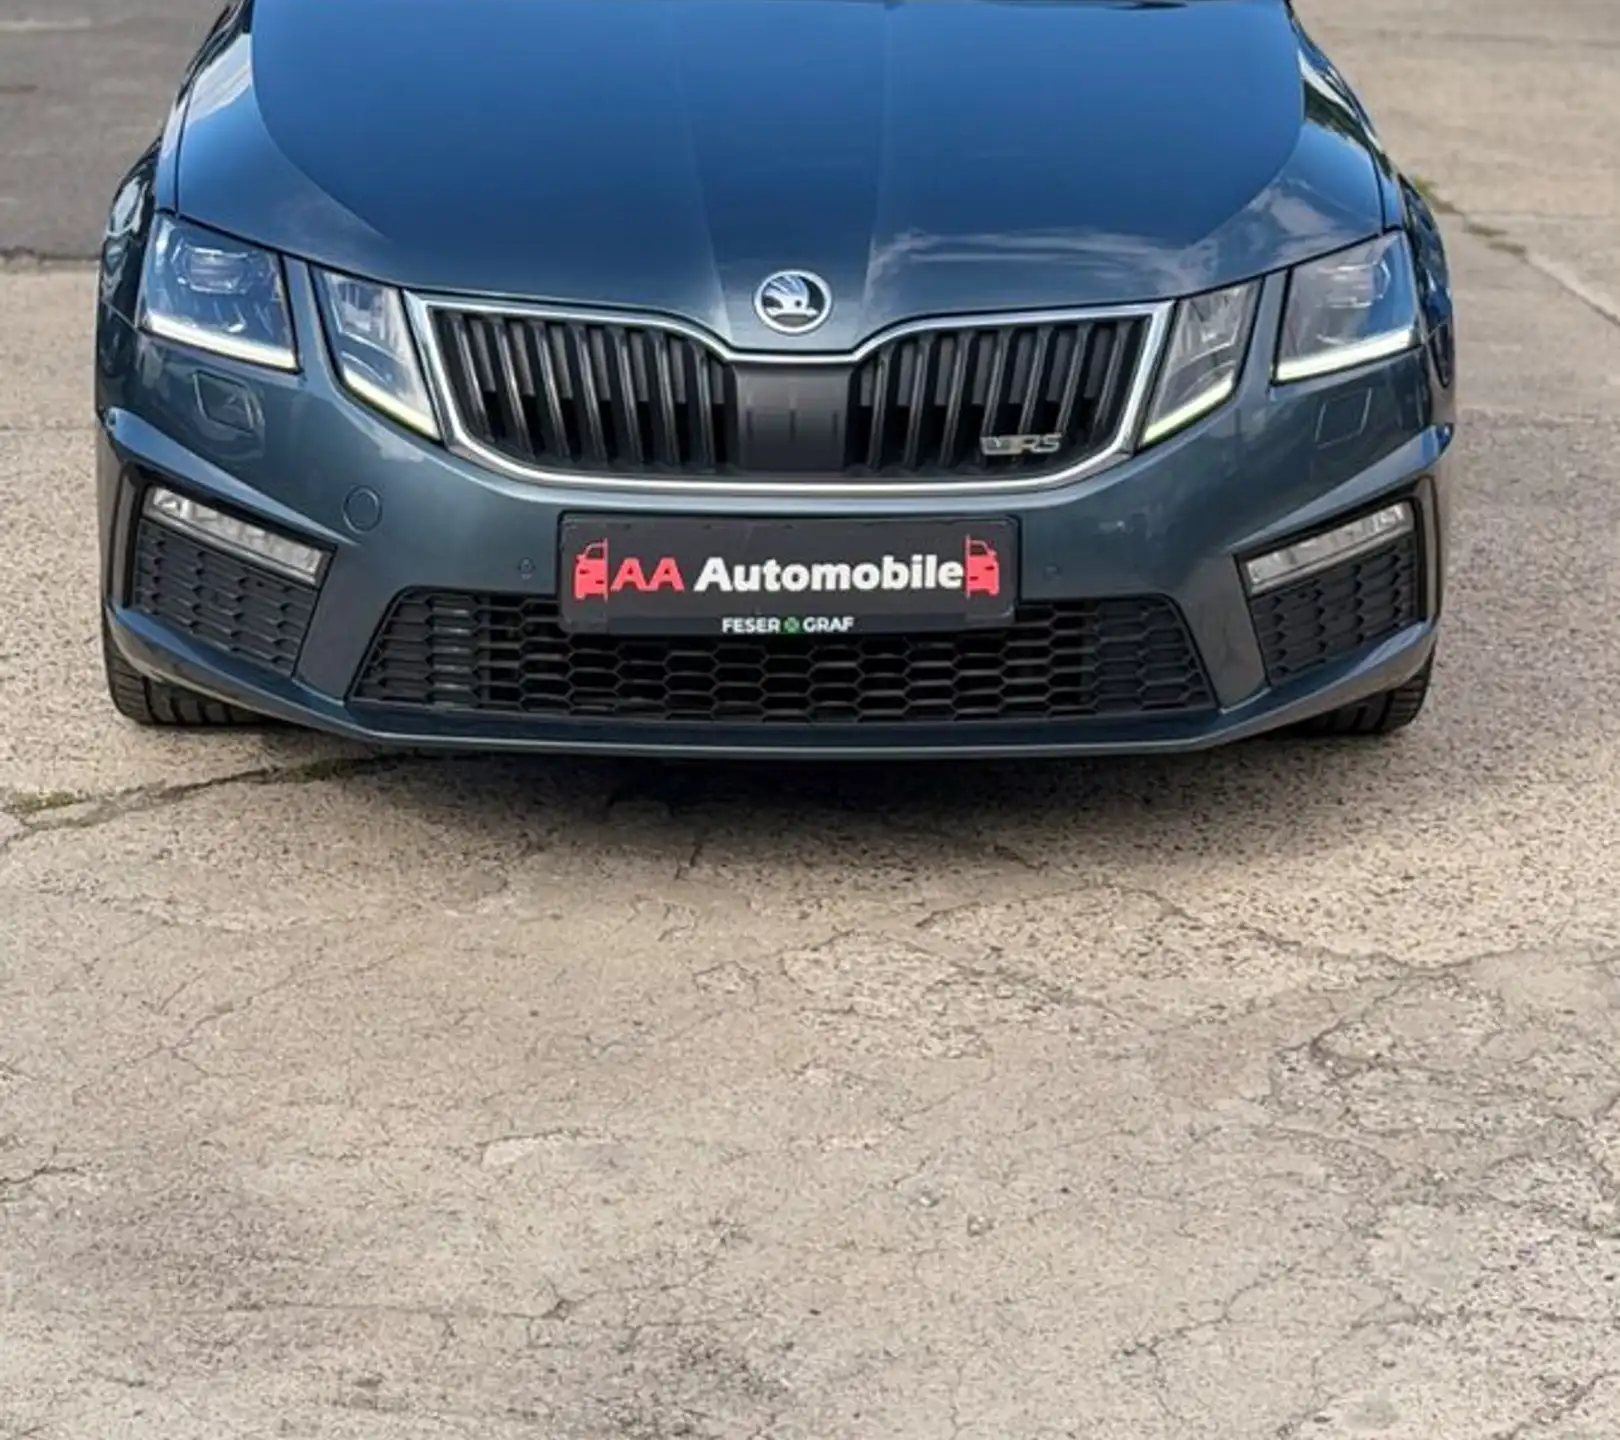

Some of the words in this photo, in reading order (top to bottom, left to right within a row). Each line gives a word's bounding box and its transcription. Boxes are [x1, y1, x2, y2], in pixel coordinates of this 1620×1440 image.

[610, 557, 685, 592] AA
[693, 554, 964, 592] Automobile
[721, 616, 781, 634] FESER
[802, 616, 855, 633] GRAF
